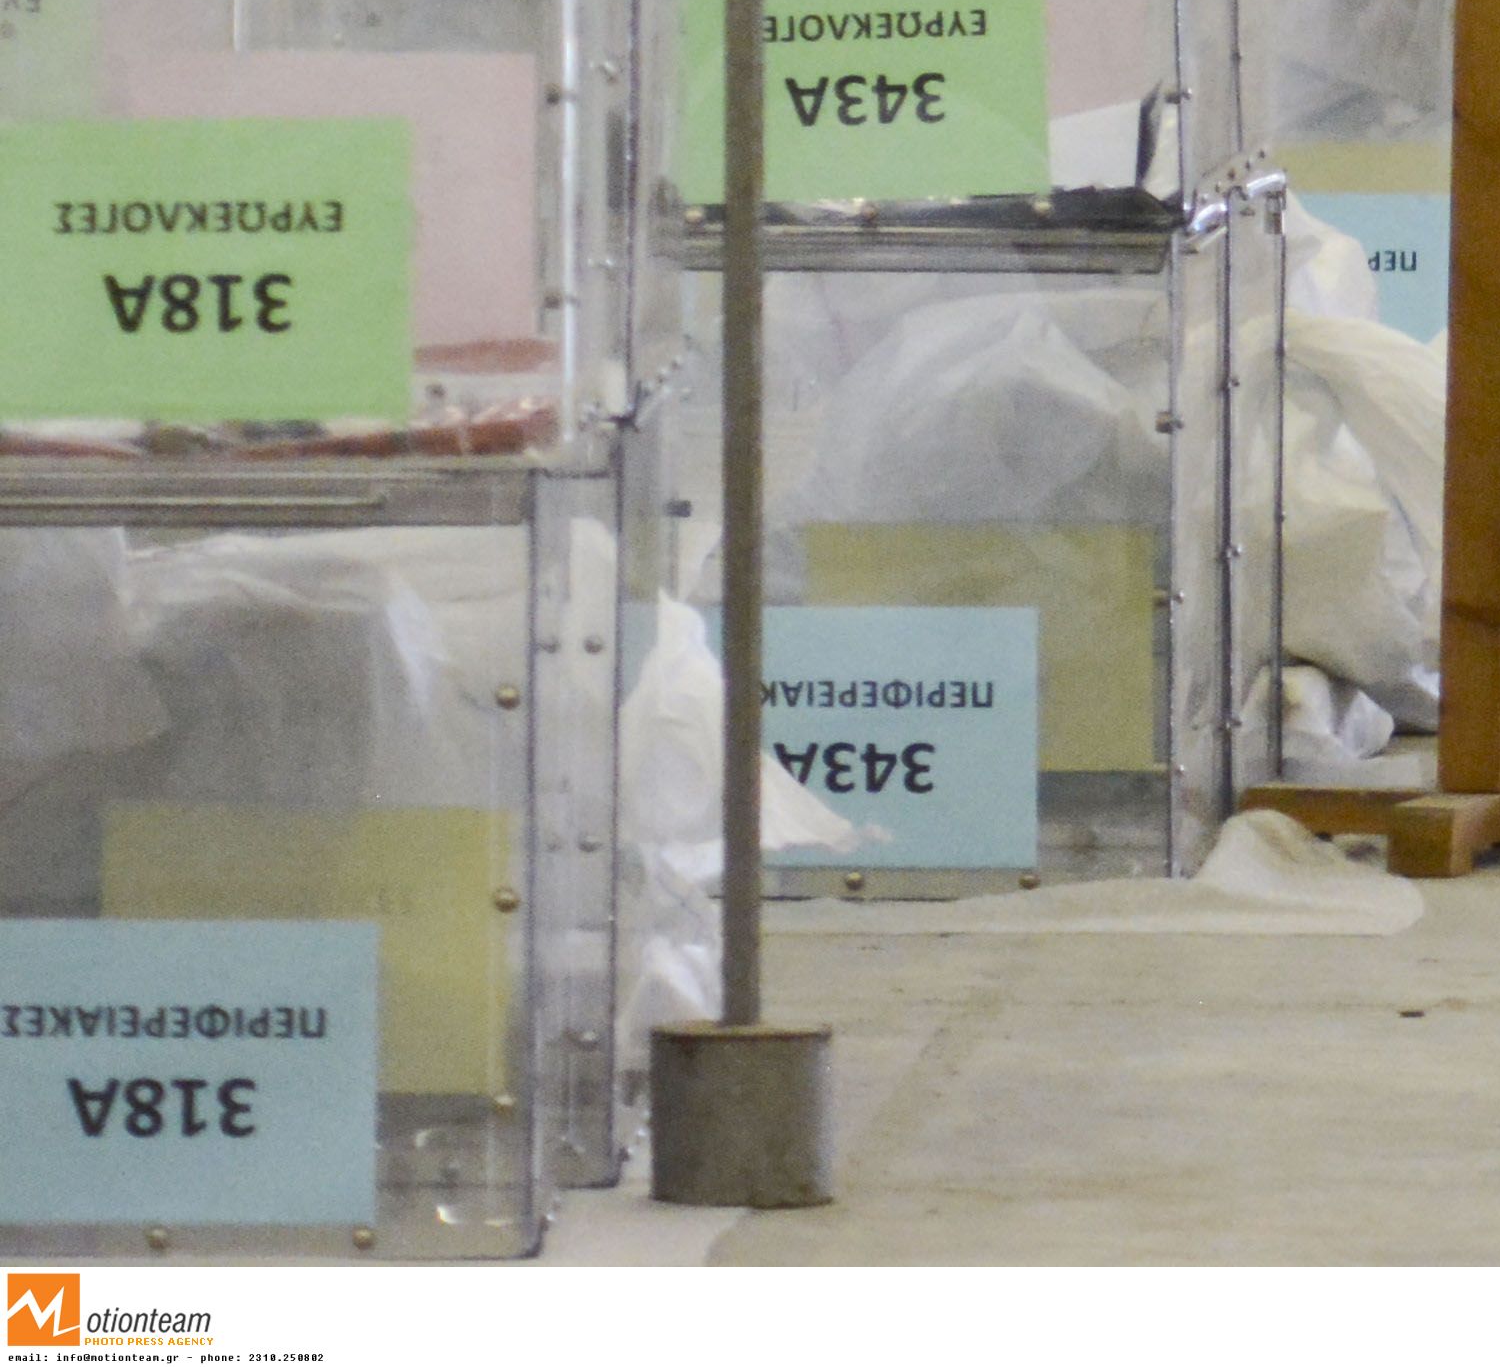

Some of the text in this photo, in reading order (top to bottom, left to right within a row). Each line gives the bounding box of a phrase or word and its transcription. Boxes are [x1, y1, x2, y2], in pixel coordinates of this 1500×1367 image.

[54, 200, 345, 235] ΕΥΡΩΕΚΛΟΓΕΣ
[103, 273, 293, 334] 318Α
[1, 1004, 328, 1040] ΠΕΡΙΦΕΡΕΙΑΚΕΣ
[67, 1077, 257, 1138] 318Α
